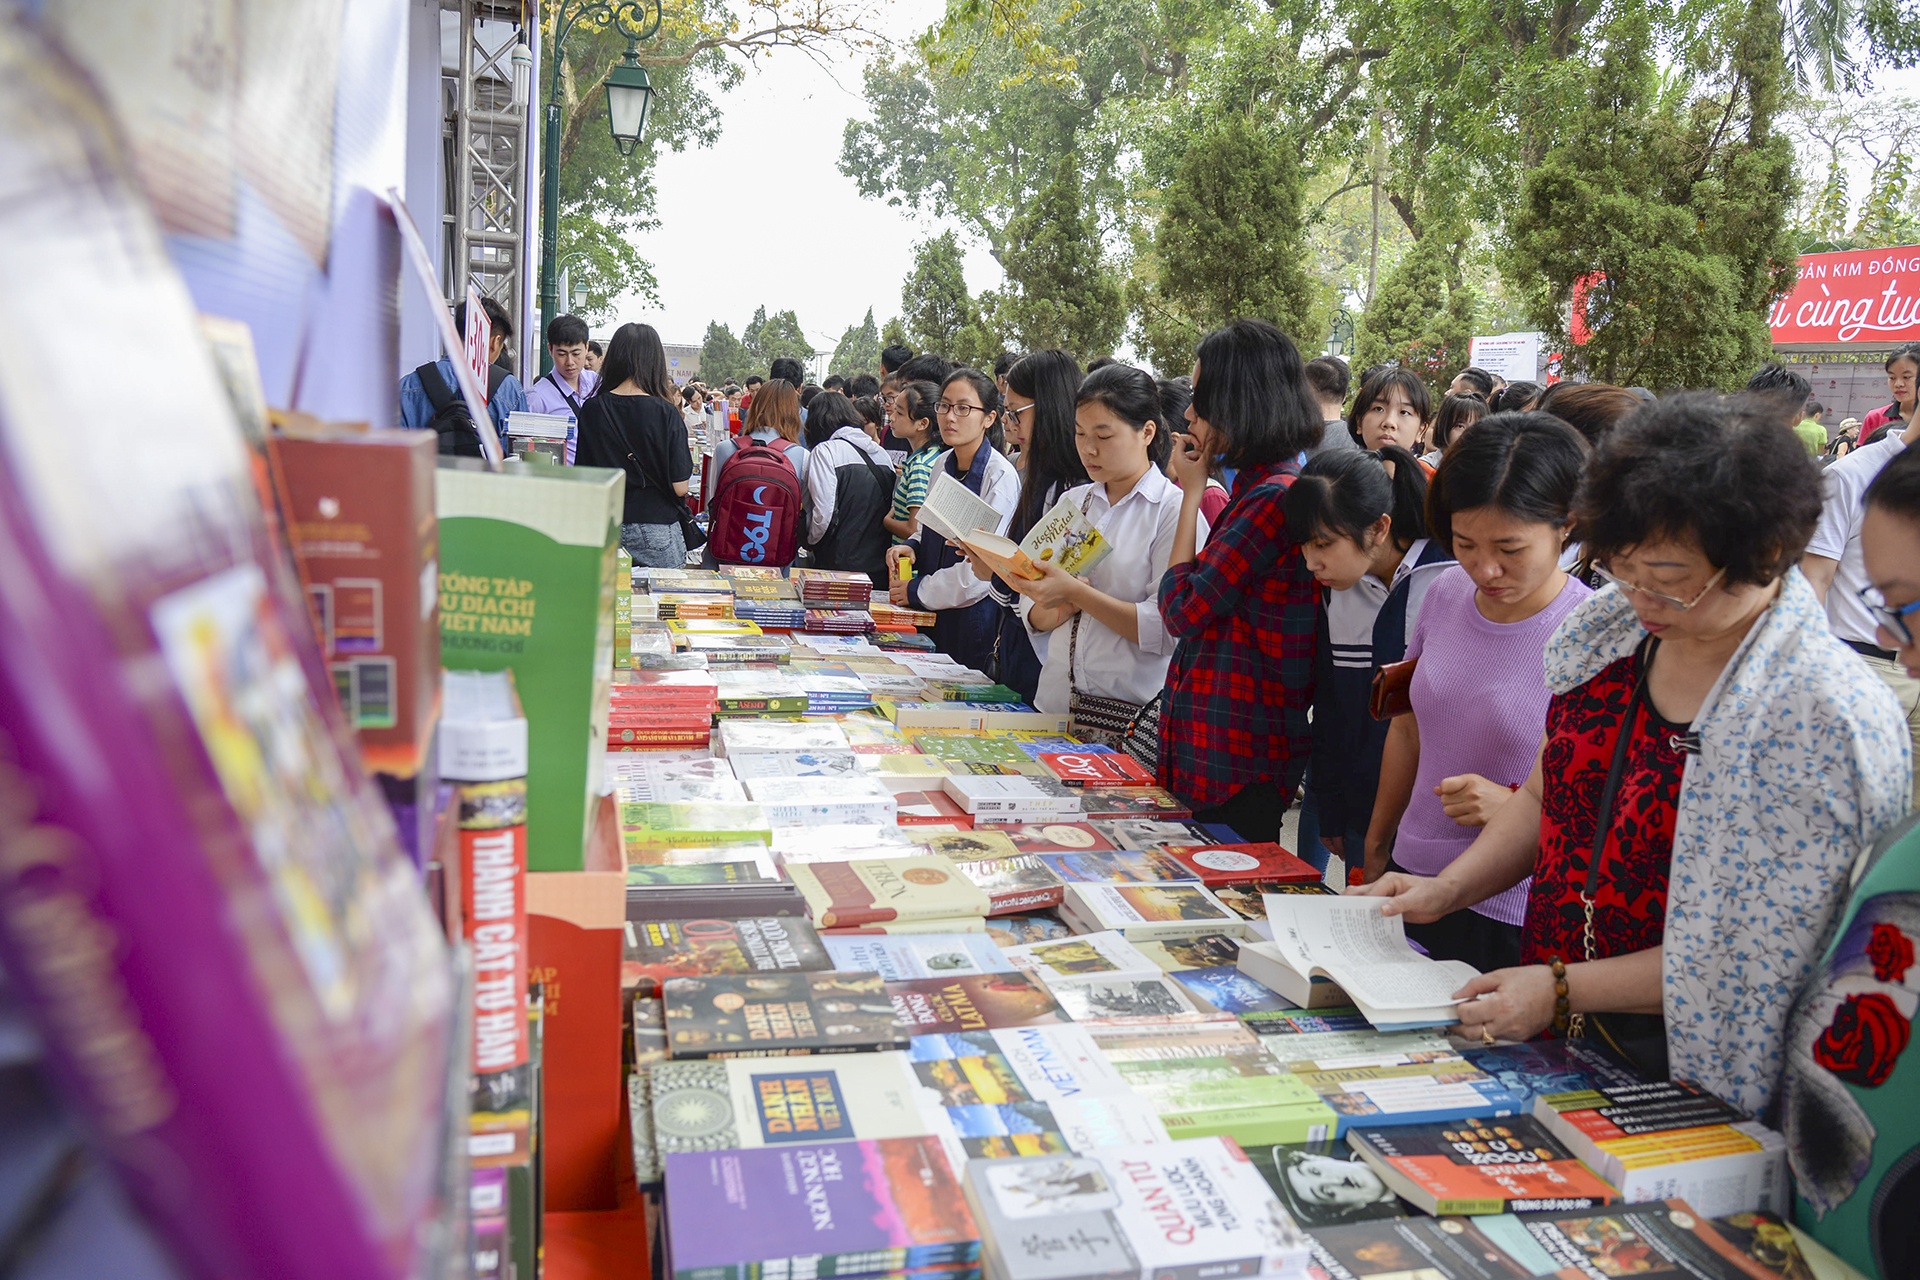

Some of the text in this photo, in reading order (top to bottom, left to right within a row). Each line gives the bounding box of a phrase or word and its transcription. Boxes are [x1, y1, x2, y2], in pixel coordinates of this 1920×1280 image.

[1833, 262, 1862, 278] KIM
[1868, 256, 1920, 275] ĐỒNG
[1796, 283, 1874, 341] cùng
[470, 311, 487, 386] -30%
[1031, 516, 1060, 550] Hector
[1046, 511, 1074, 543] Malot
[481, 615, 533, 637] NAM
[473, 831, 520, 920] THÀNH
[474, 922, 520, 971] CÁT
[682, 919, 739, 943] 10
[477, 1010, 520, 1067] HÃN
[743, 1004, 772, 1041] DANH
[766, 1003, 796, 1040] NHÂN
[1017, 1028, 1057, 1063] NAM
[759, 1080, 793, 1133] DANH
[784, 1079, 820, 1132] NHÂN
[811, 1077, 842, 1130] VIỆT NAM
[1136, 1185, 1196, 1246] QUẢN
